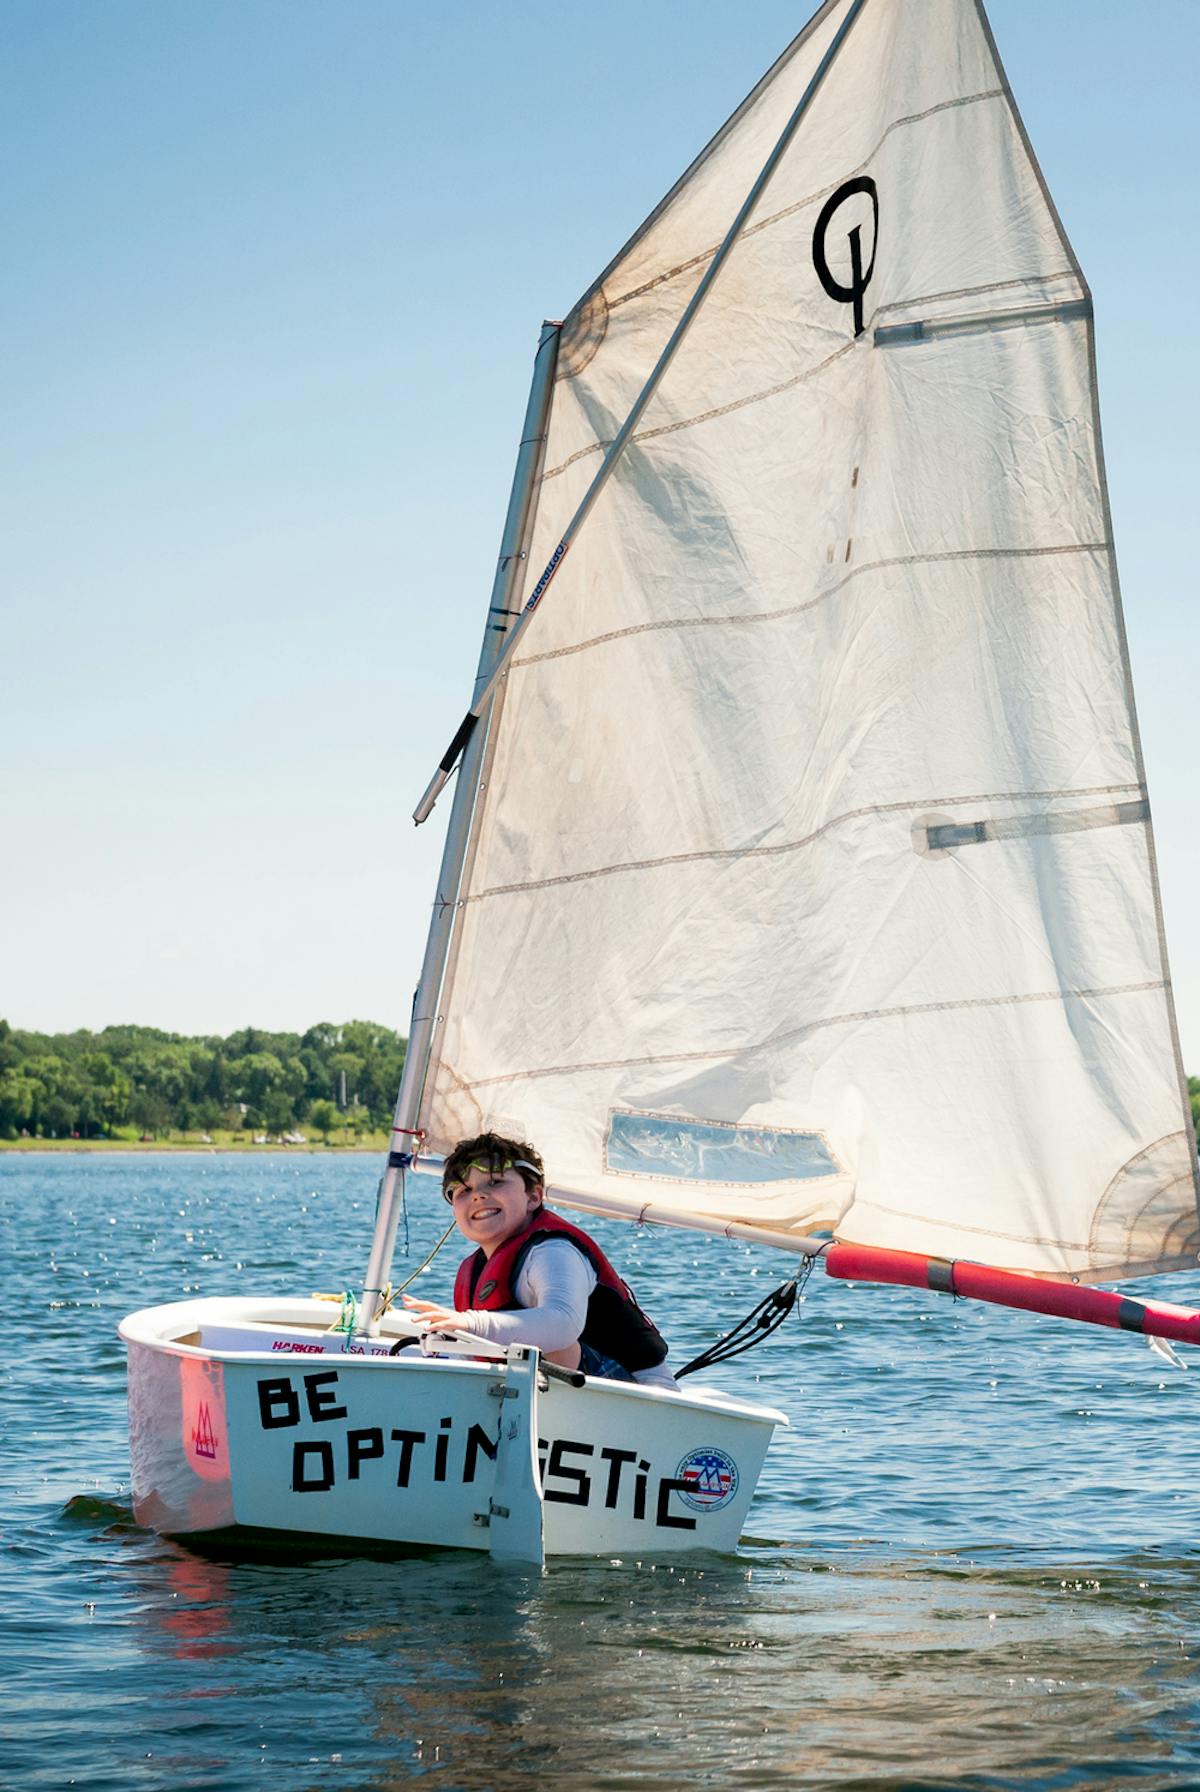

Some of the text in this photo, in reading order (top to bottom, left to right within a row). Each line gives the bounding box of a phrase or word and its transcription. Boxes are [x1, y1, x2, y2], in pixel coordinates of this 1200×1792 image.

[526, 543, 564, 608] OPTIPARTS
[272, 1341, 324, 1353] HARKEN
[257, 1371, 347, 1429] BE
